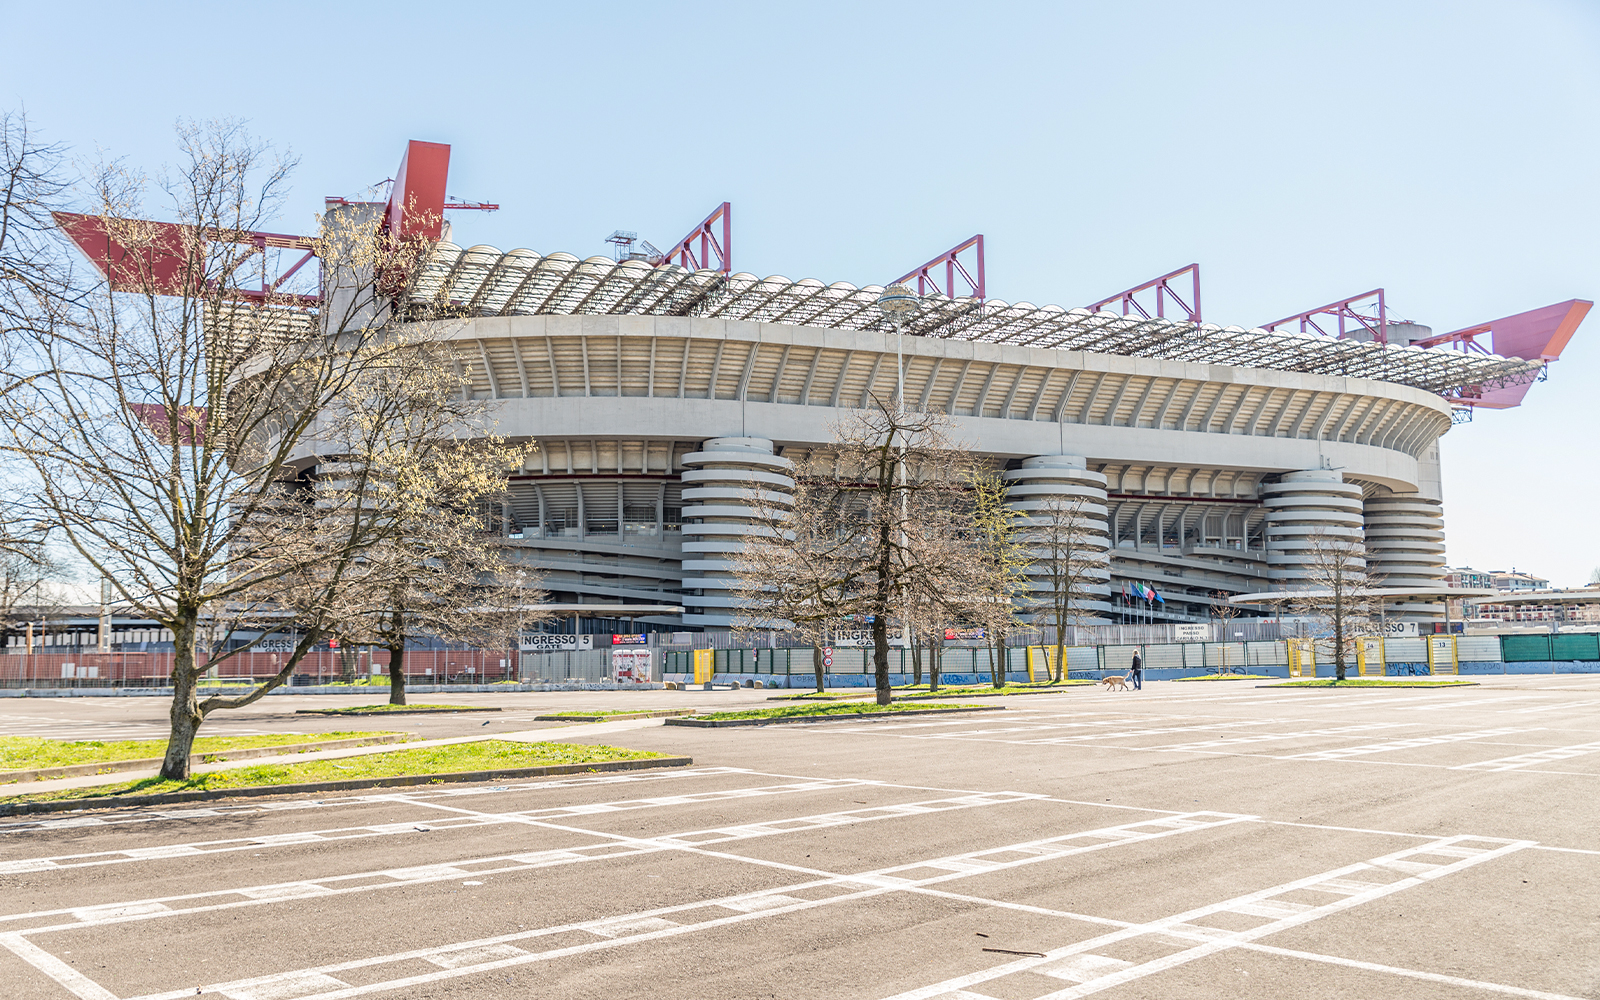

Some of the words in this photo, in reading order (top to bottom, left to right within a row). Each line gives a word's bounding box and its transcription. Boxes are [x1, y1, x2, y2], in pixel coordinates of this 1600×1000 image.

[1410, 623, 1416, 632] 7
[521, 636, 576, 644] INGRESSO
[583, 636, 590, 644] 5
